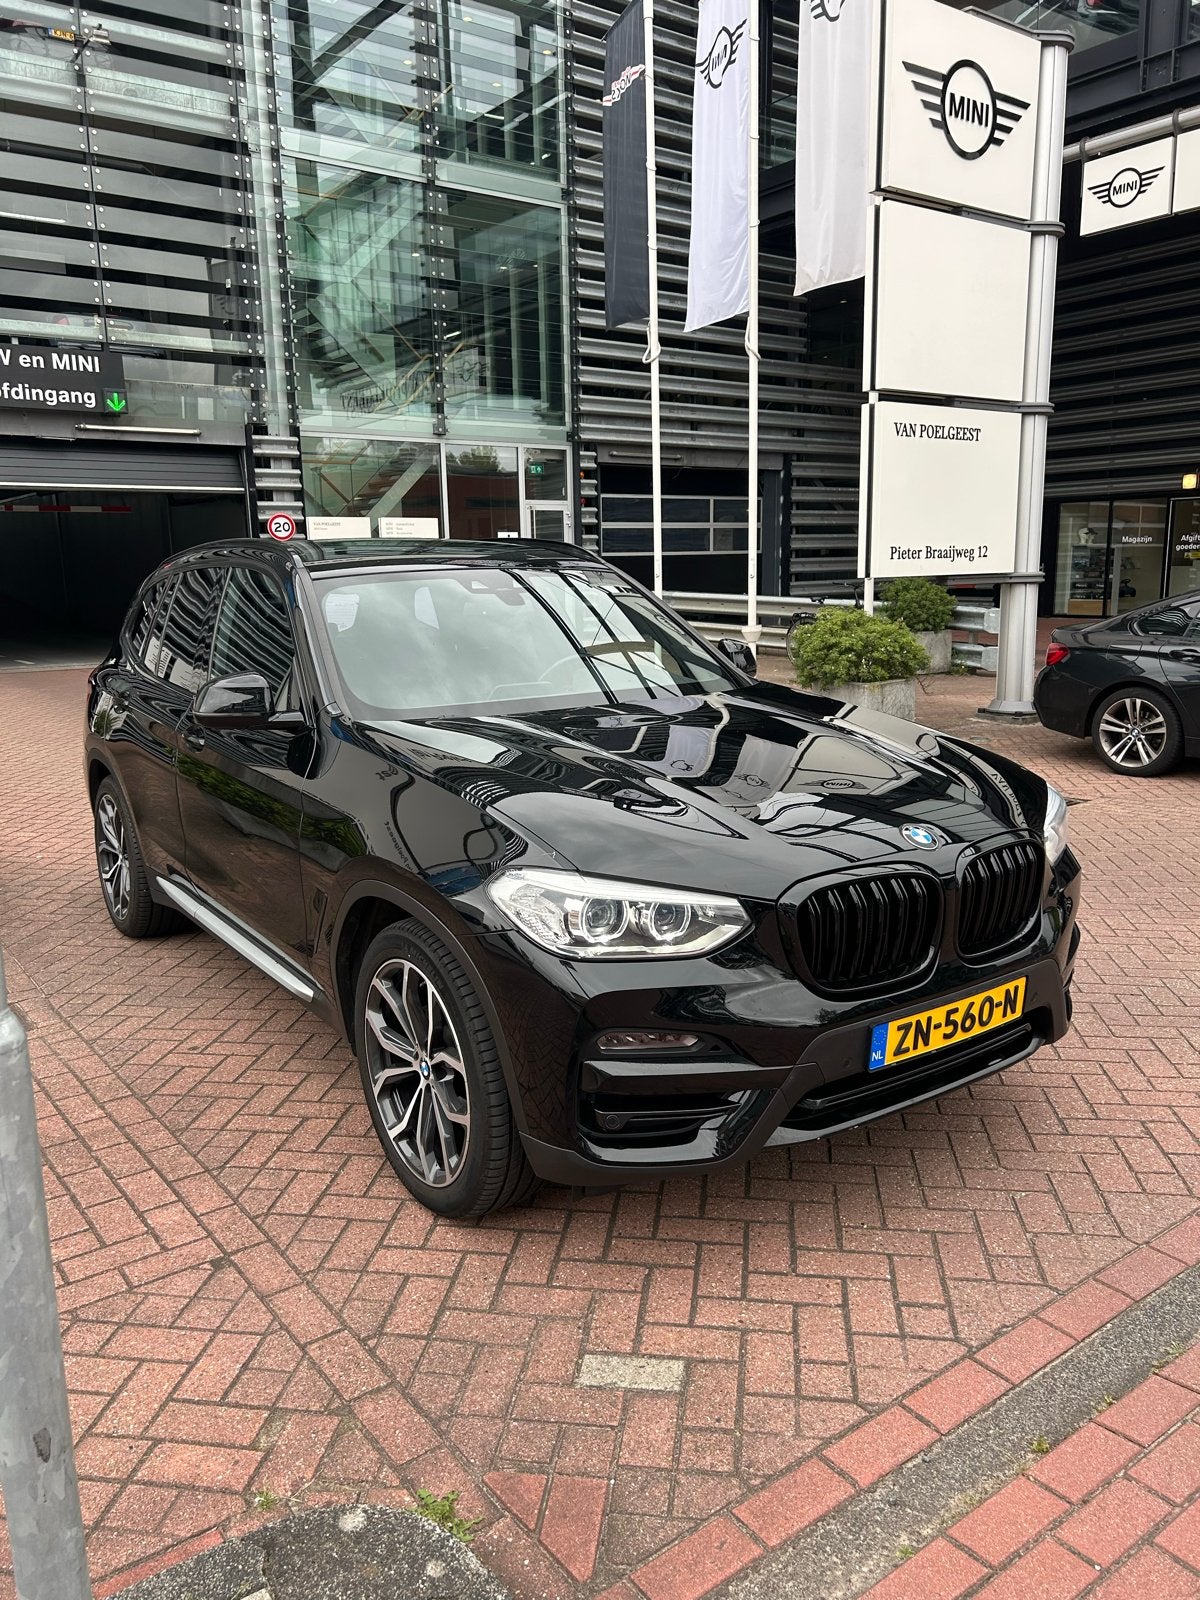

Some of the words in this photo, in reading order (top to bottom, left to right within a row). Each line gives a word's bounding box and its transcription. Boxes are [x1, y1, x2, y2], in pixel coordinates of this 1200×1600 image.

[949, 92, 990, 128] MINI
[1112, 180, 1138, 196] MINI
[18, 353, 45, 369] en
[51, 352, 100, 373] MINI
[0, 382, 97, 408] fdingang
[893, 422, 917, 437] VAN
[919, 423, 982, 441] POELGEEST
[274, 521, 291, 533] 20
[1121, 535, 1153, 544] Magazijn
[890, 546, 922, 560] Pieter
[924, 545, 975, 563] Braaijweg
[977, 545, 989, 559] 12
[893, 984, 1020, 1057] ZN-560-N
[871, 1049, 884, 1062] NL
